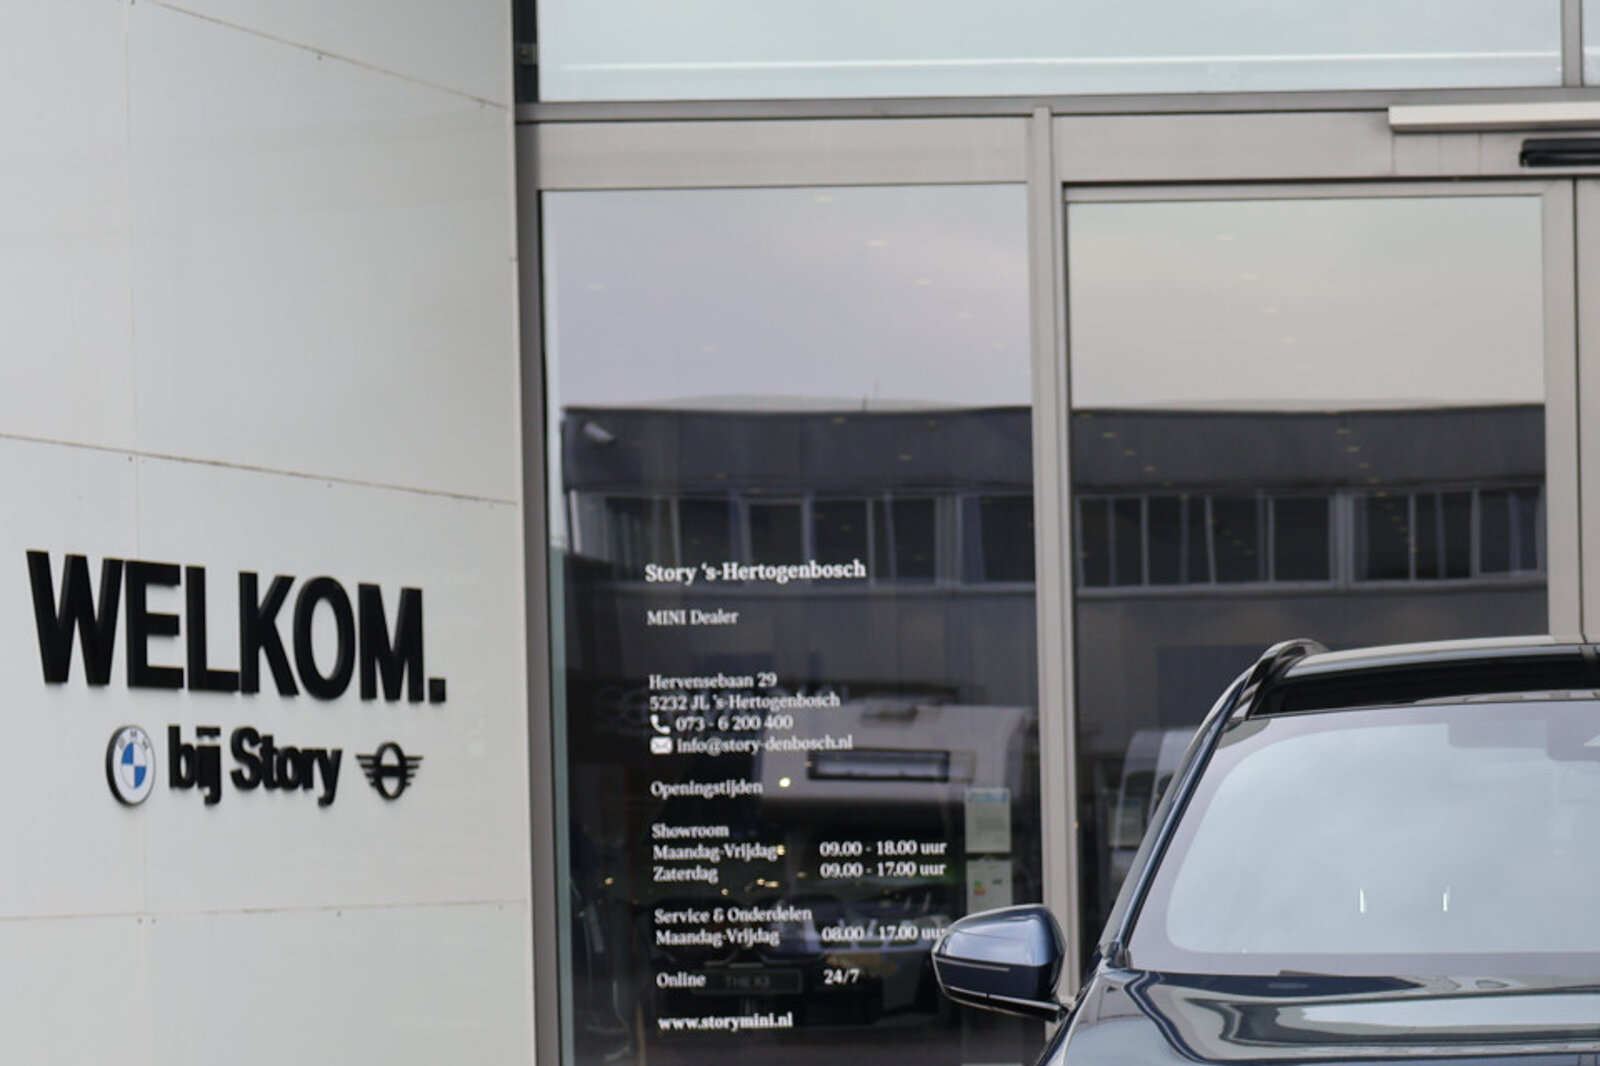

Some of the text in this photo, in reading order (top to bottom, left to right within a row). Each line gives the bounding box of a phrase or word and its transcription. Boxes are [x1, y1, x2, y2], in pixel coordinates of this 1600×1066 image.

[644, 559, 867, 586] Story 's-Hertogenbosch
[647, 608, 739, 625] MINI Dealer
[26, 550, 447, 704] WELKOM.
[649, 672, 778, 690] Hervensebaan 29
[649, 692, 841, 711] 5232 JL 's-Hertogenbosch
[675, 716, 705, 731] 073
[718, 715, 728, 731] 6
[732, 715, 761, 730] 200
[764, 714, 793, 730] 400
[677, 734, 853, 756] info@story-denbosch.nl
[167, 725, 343, 807] bij Story
[651, 780, 763, 799] Openingstijden
[652, 824, 729, 839] Showroom
[653, 843, 778, 863] Maandag-Vrijdag
[819, 842, 862, 857] 09.00
[876, 841, 916, 856] 18.00
[920, 842, 947, 855] uur
[653, 865, 718, 884] Zaterdag
[820, 863, 863, 879] 09.00
[877, 862, 916, 877] 17.00
[920, 863, 947, 876] uur
[654, 906, 812, 924] Service & Onderdelen
[656, 929, 780, 948] Maandag-Vrijdag
[822, 926, 864, 941] 08.00
[878, 925, 918, 941] 17.00
[656, 969, 860, 988] Online 24/7
[658, 1012, 793, 1033] www.storymini.nl
